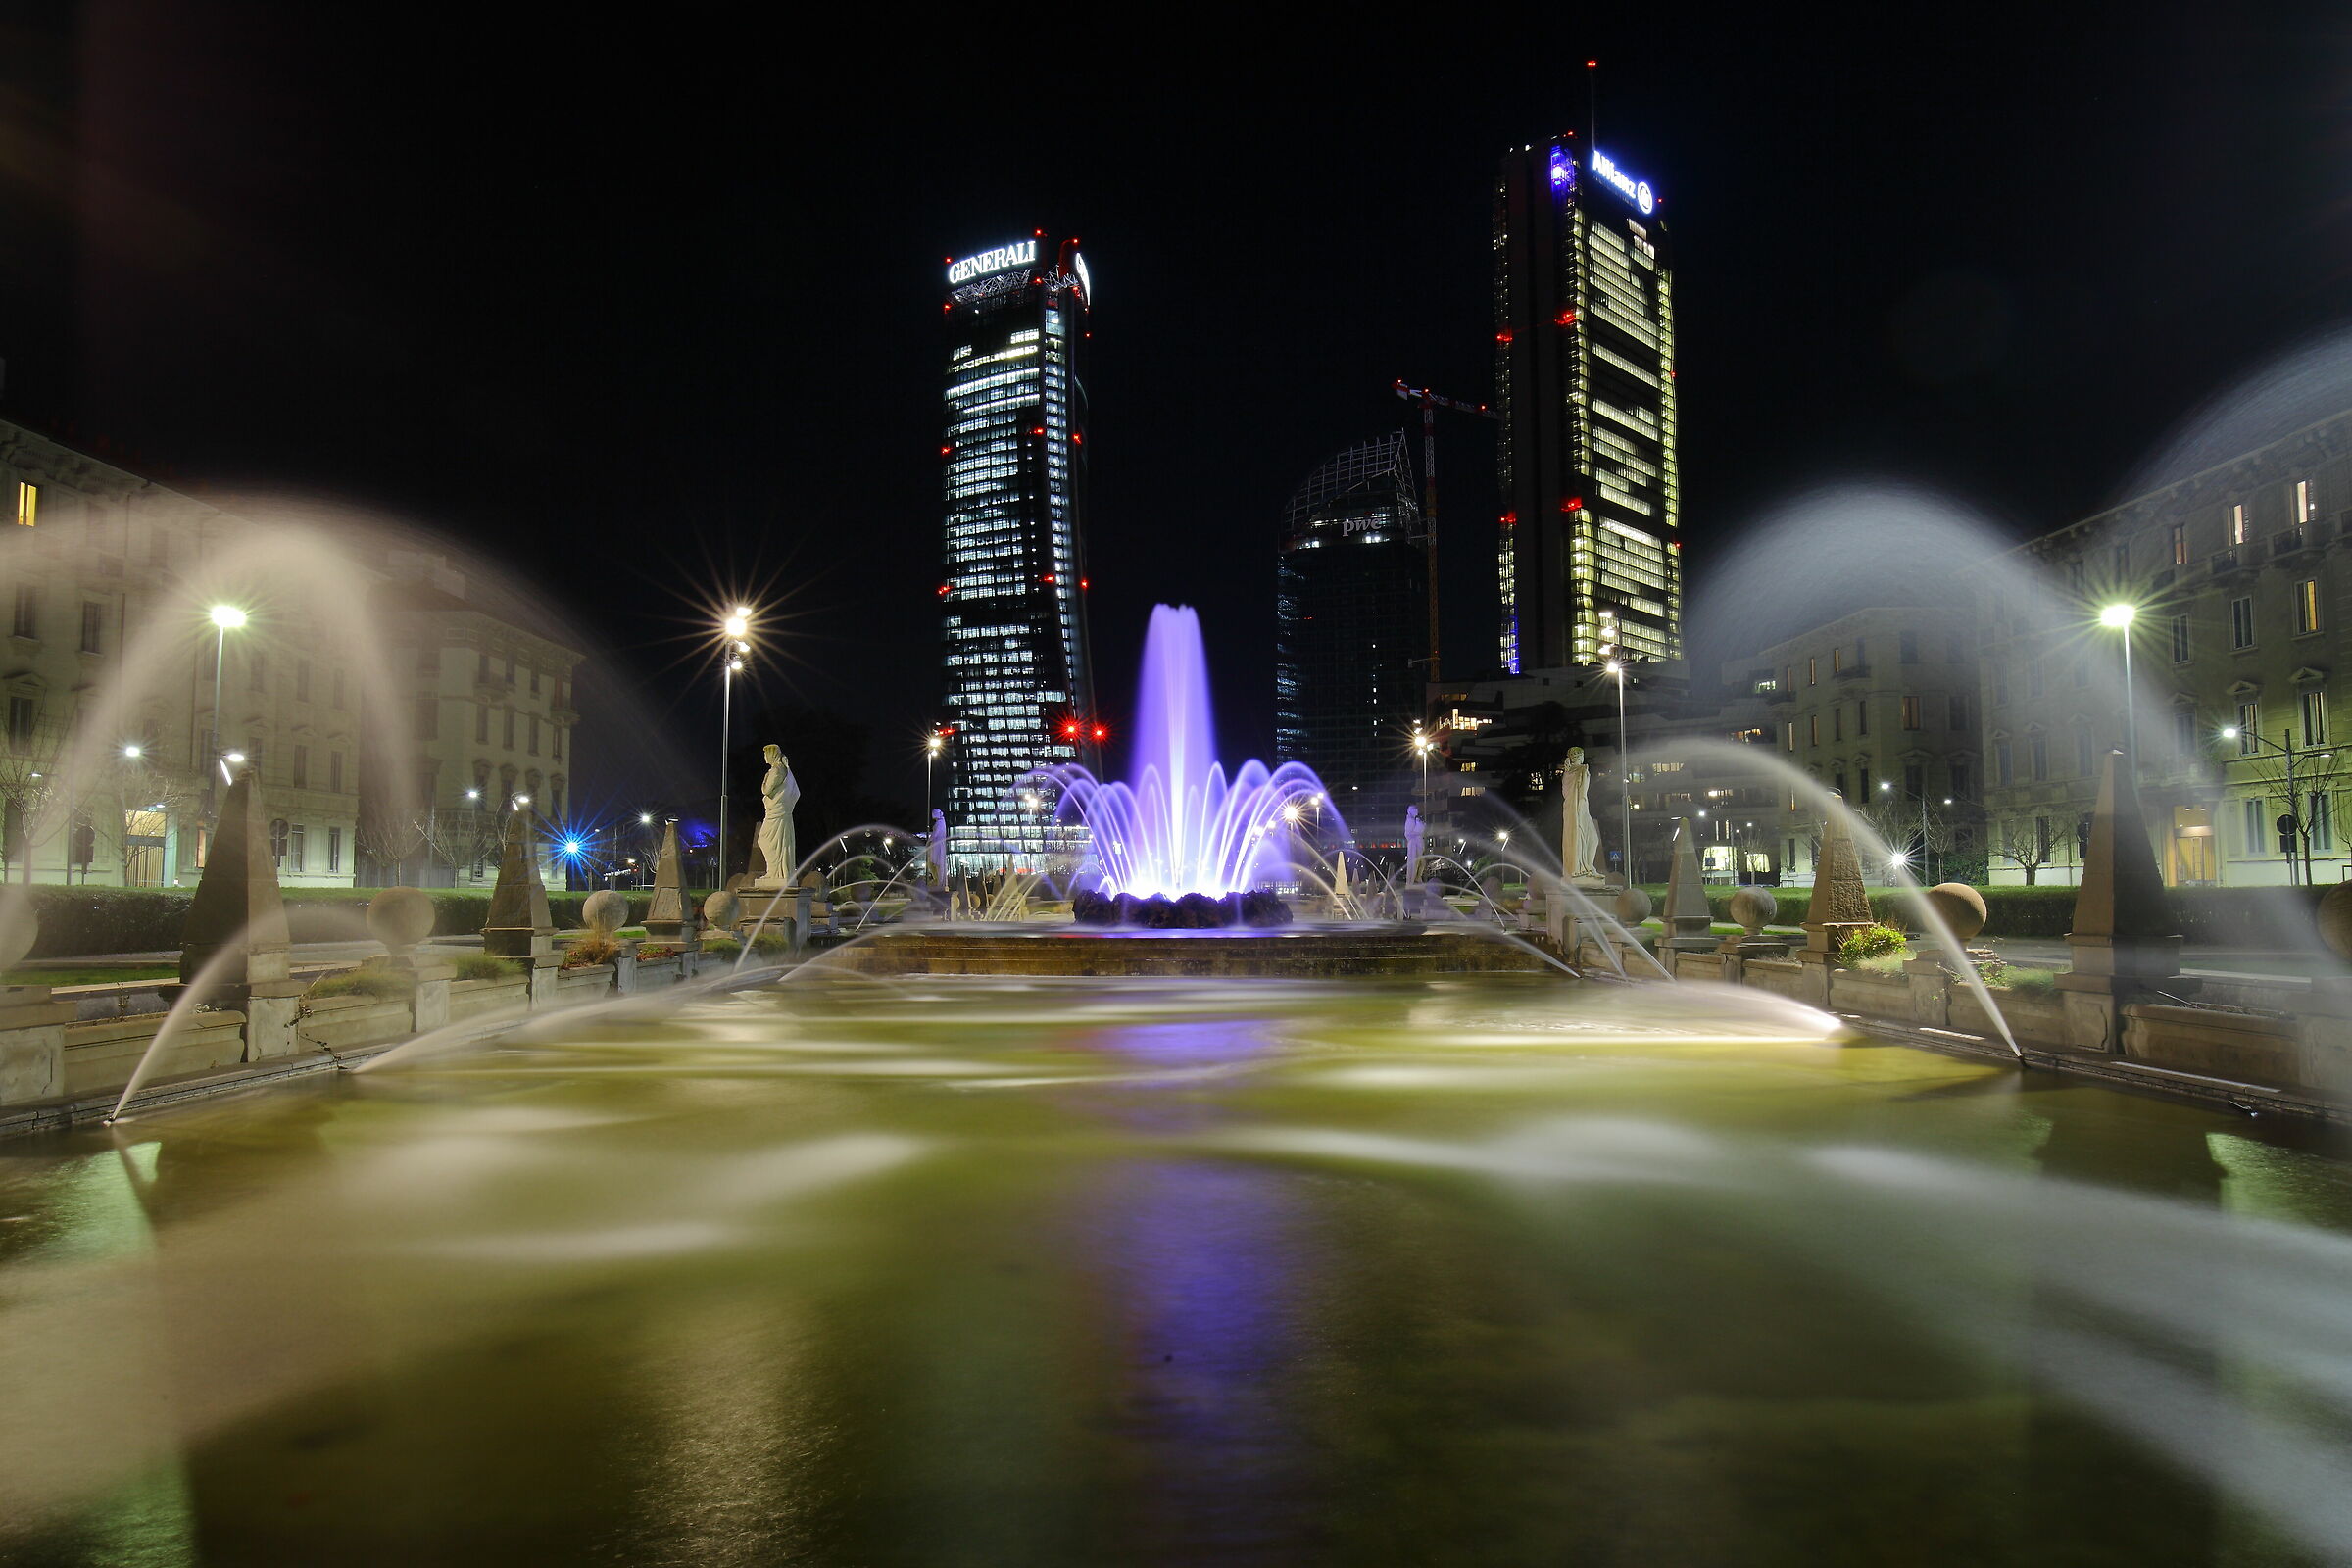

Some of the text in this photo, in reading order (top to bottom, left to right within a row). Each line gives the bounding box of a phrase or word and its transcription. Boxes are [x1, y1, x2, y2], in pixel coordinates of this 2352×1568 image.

[1592, 150, 1636, 199] Allianz
[949, 241, 1036, 283] GENERALI
[1343, 517, 1382, 537] pwc
